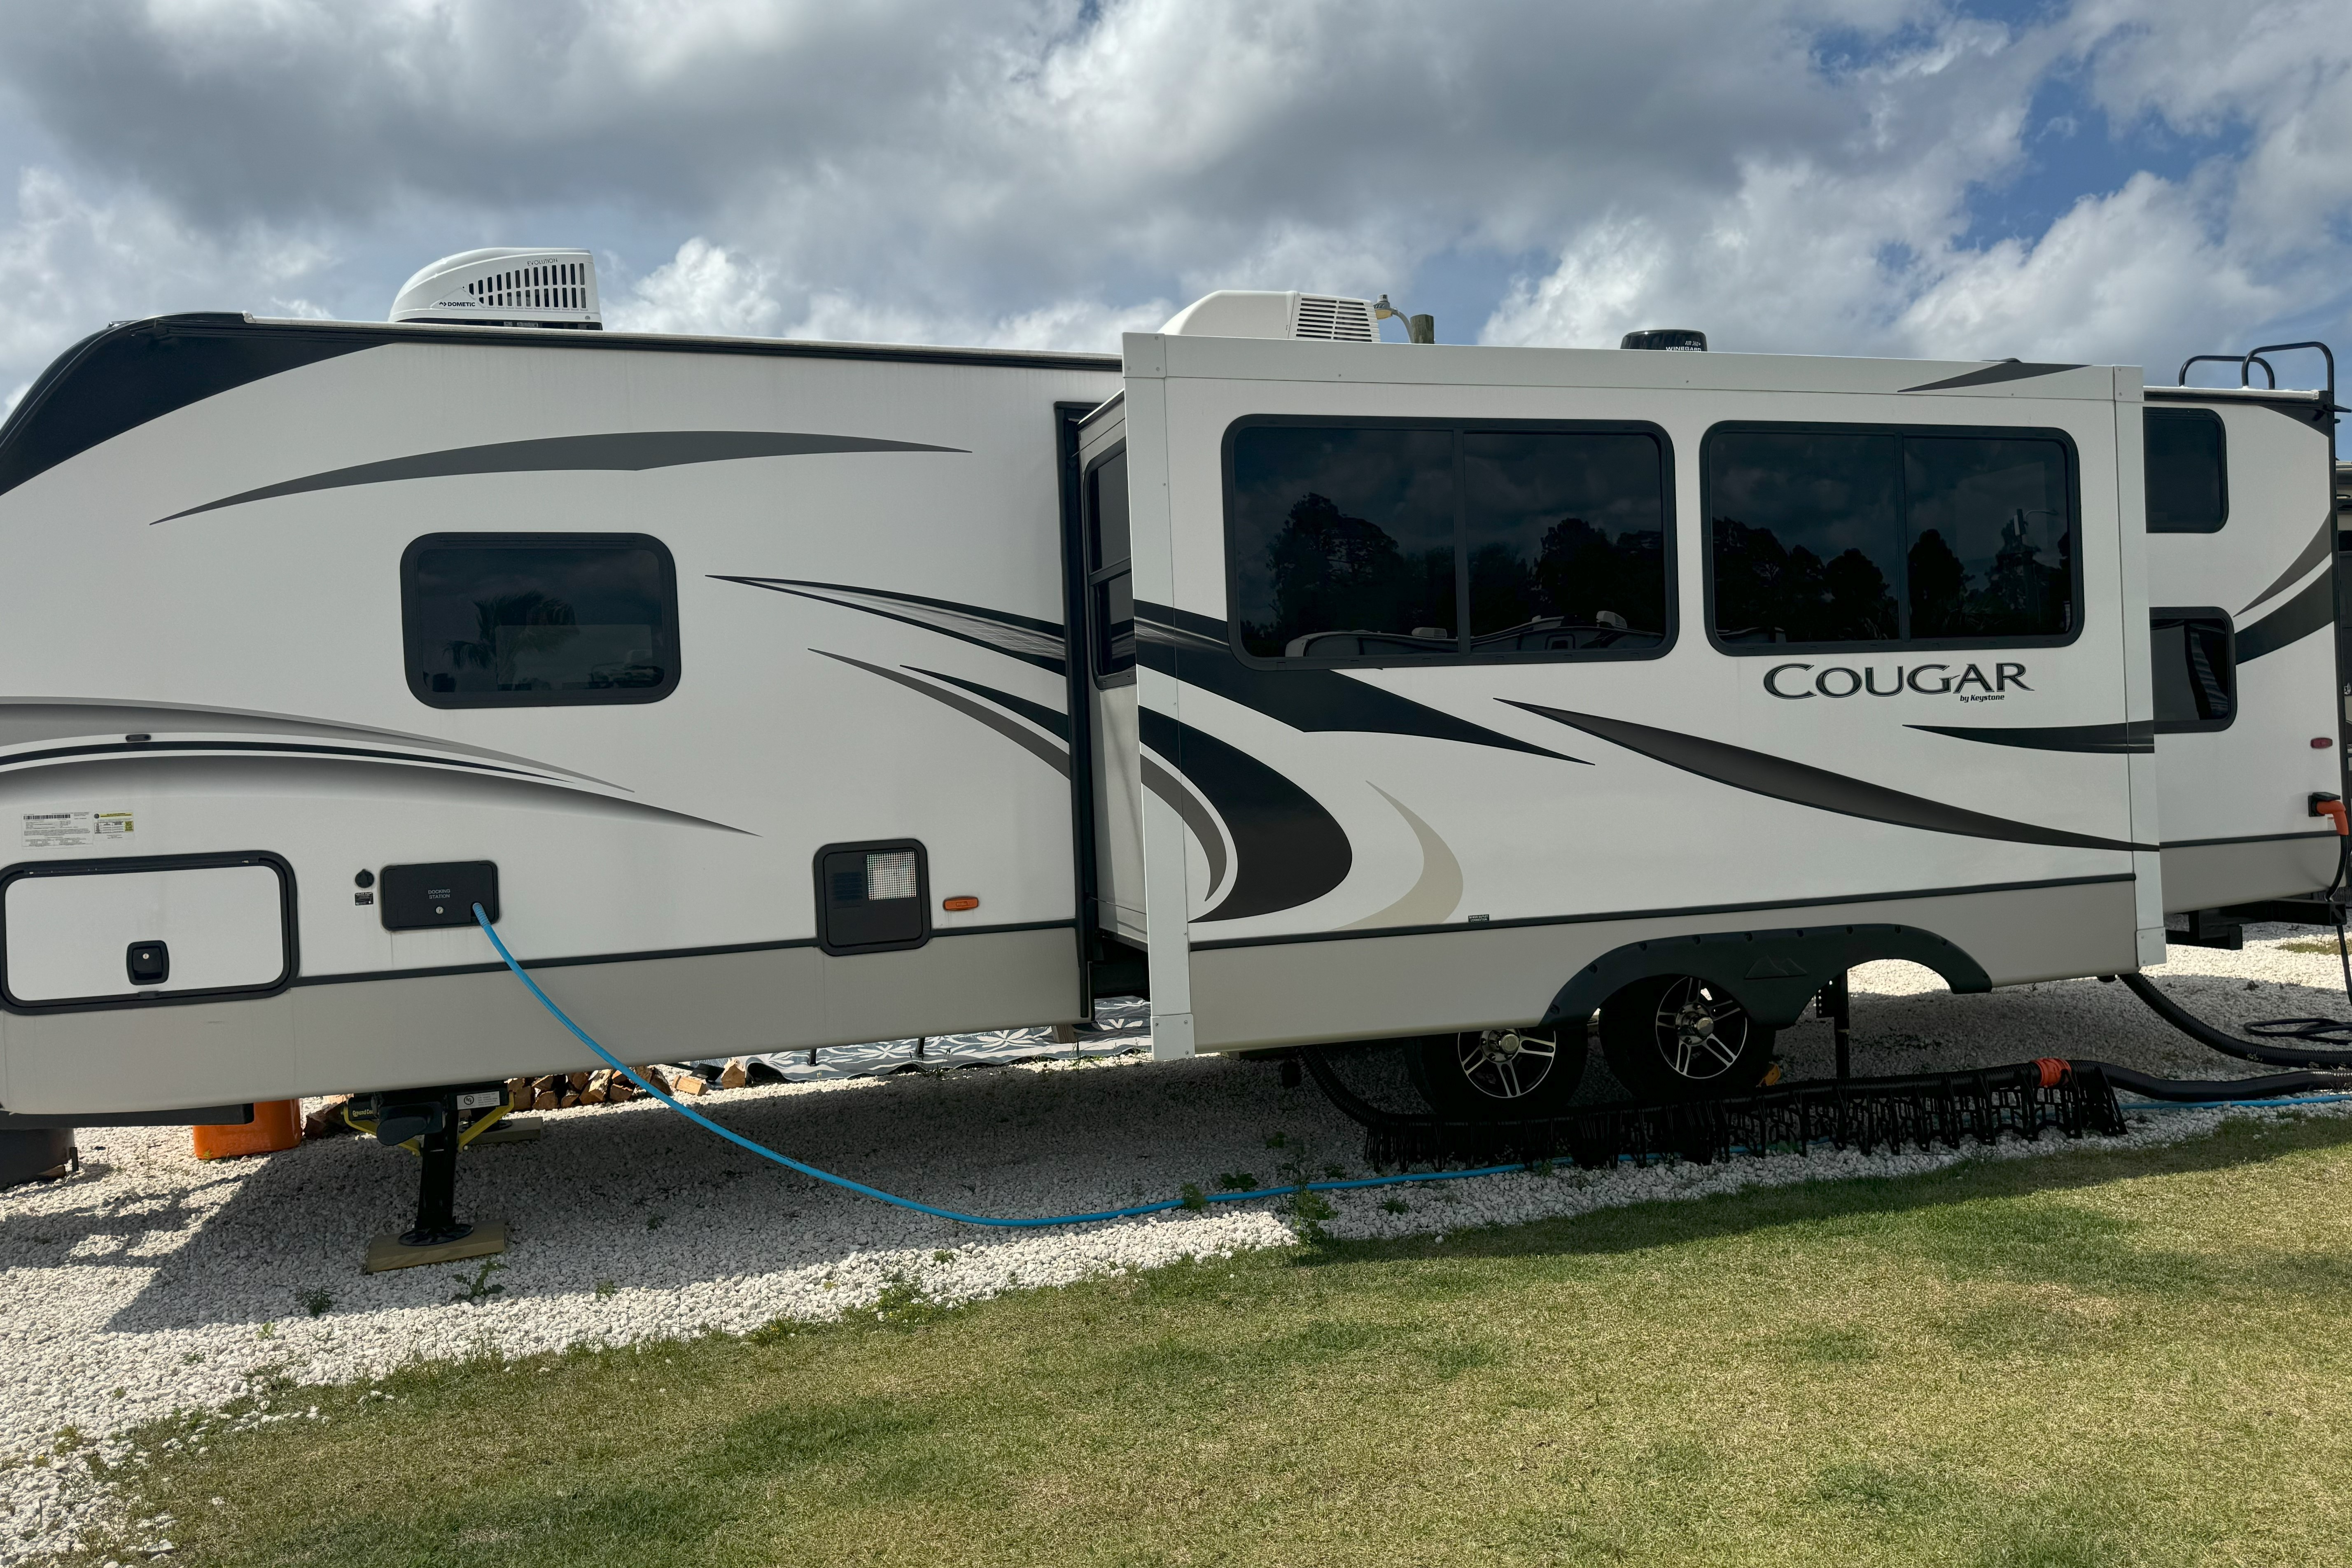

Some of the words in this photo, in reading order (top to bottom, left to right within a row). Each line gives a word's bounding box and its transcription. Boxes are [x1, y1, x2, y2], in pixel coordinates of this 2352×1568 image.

[527, 258, 558, 266] EVOLUTION
[1763, 663, 2035, 700] COUGAR
[1970, 694, 2004, 702] Keystone
